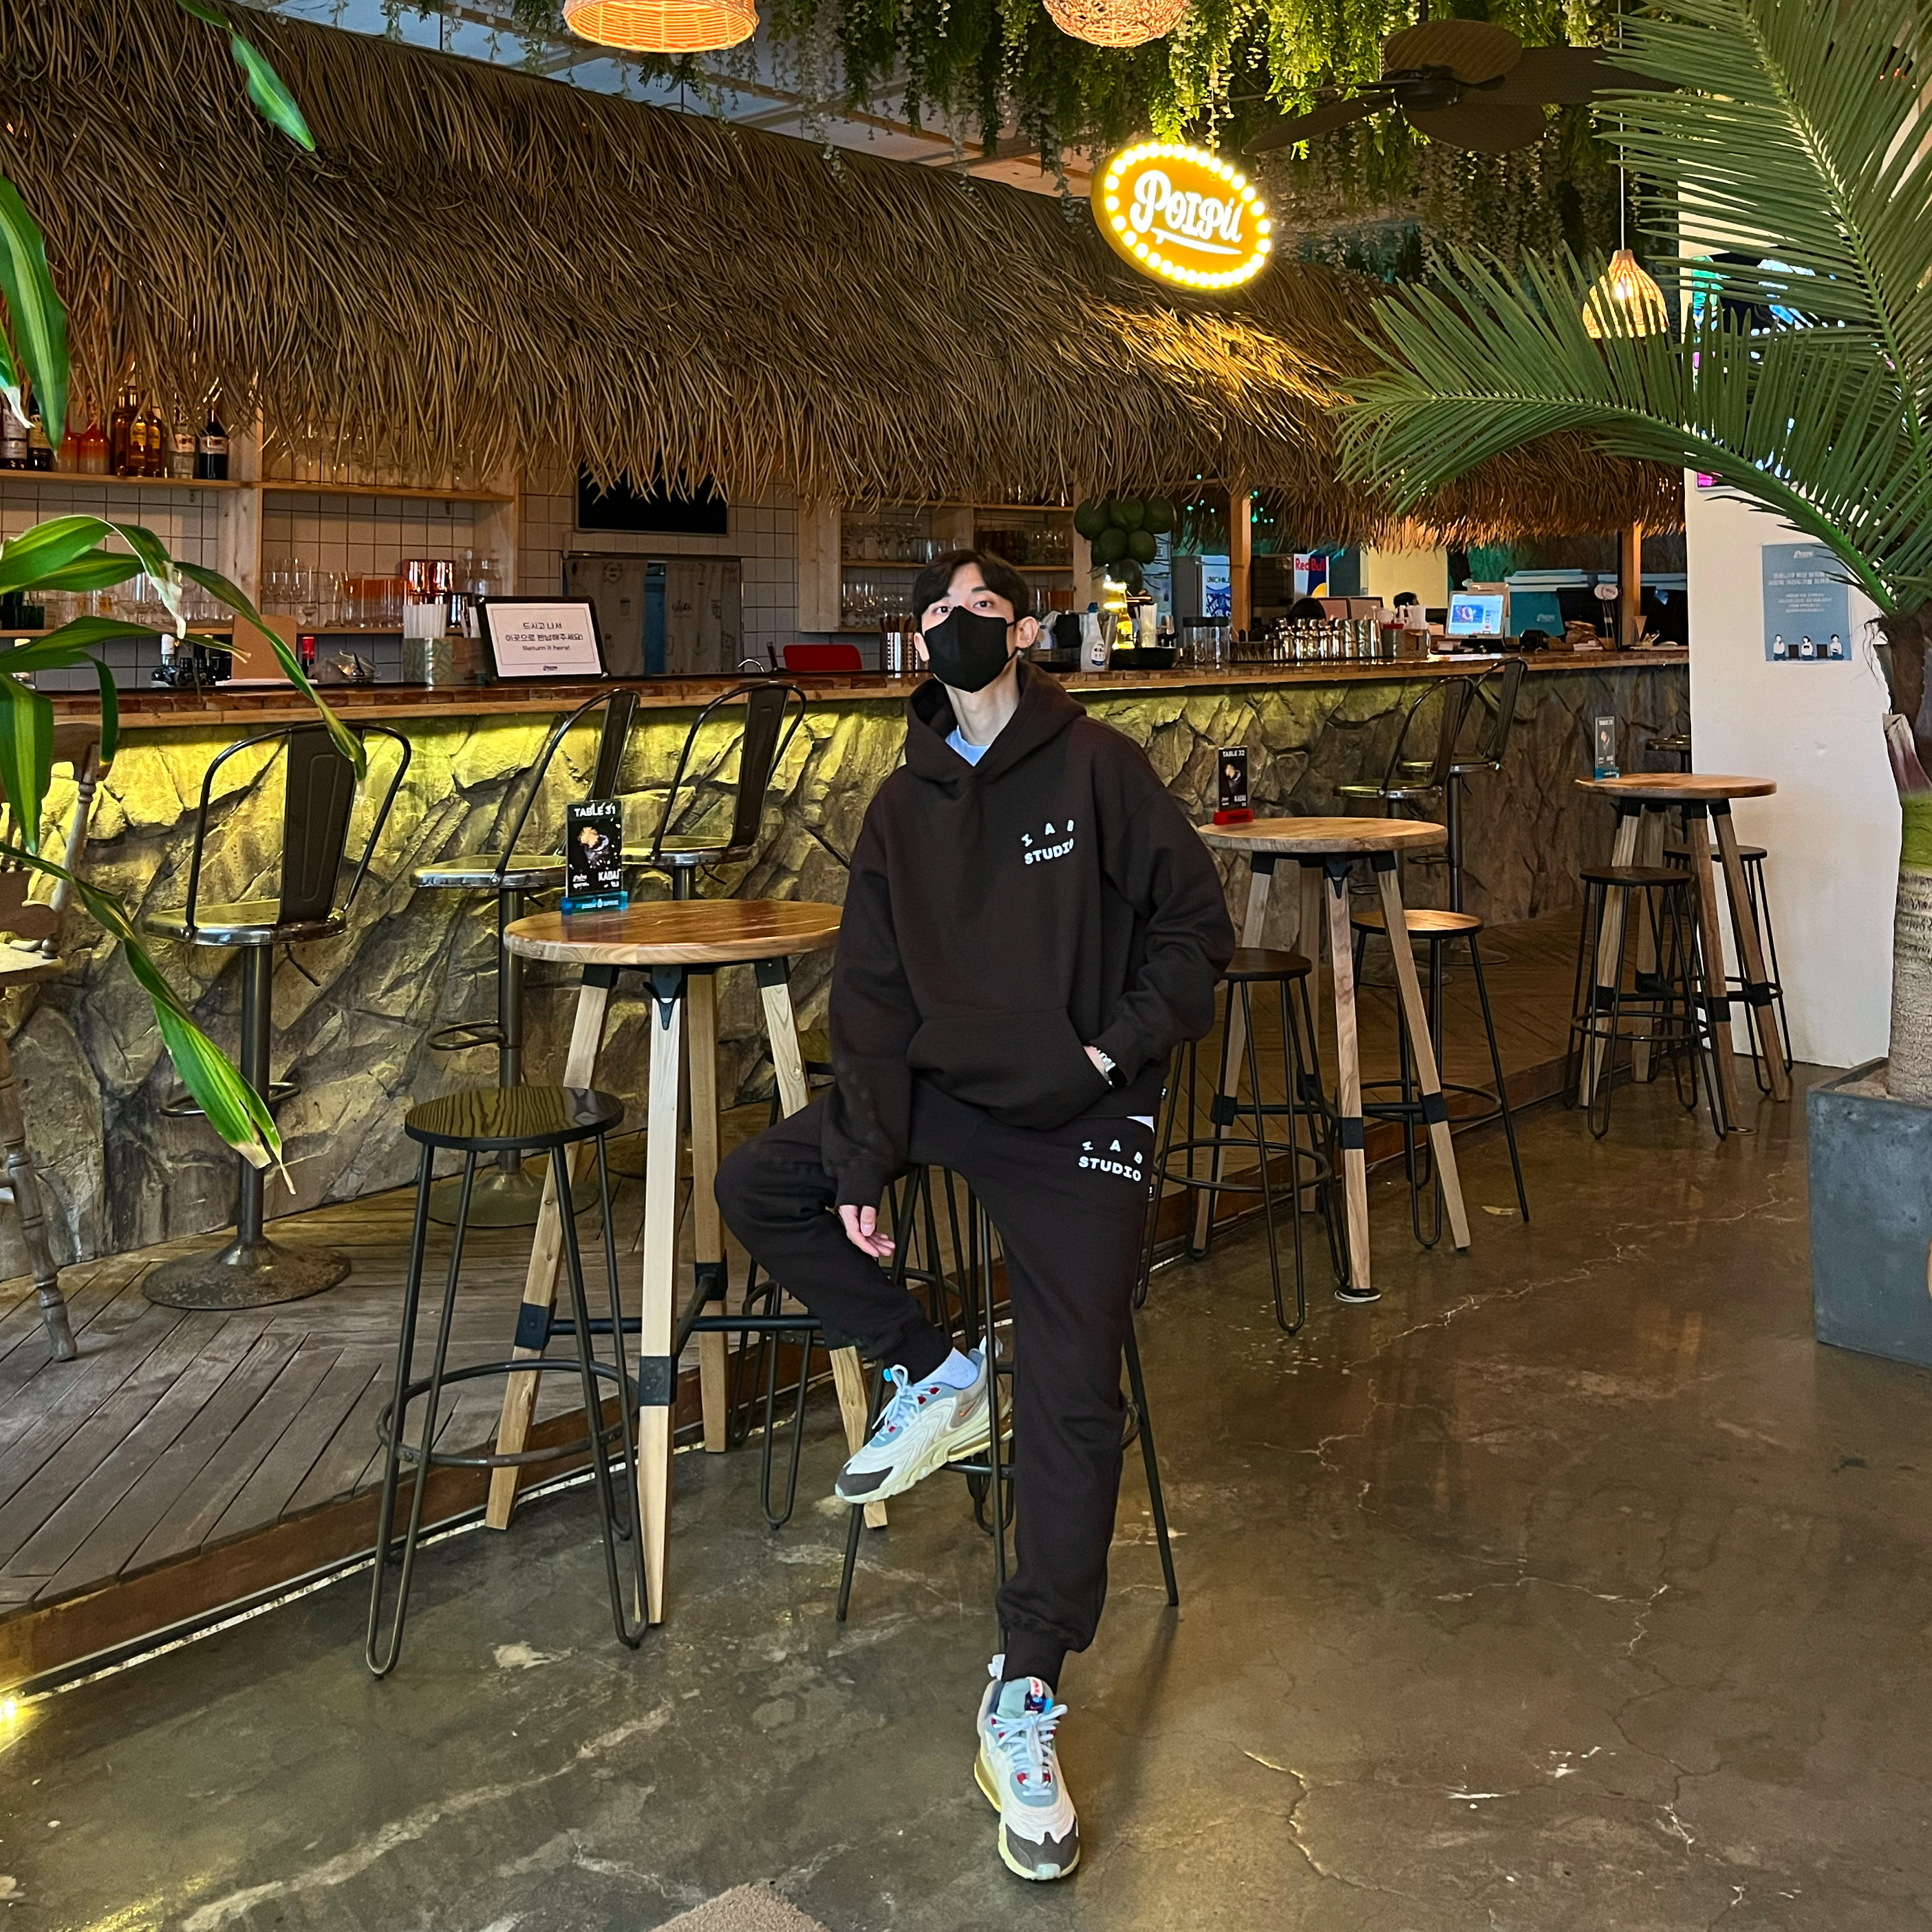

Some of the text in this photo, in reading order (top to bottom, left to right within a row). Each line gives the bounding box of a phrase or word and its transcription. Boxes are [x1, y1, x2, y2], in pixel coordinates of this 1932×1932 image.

[1296, 557, 1325, 571] Red Bull
[505, 634, 535, 642] 이곳으로
[574, 805, 604, 817] TABLE
[1024, 838, 1074, 865] STUDIO
[1078, 1156, 1141, 1181] STUDIO
